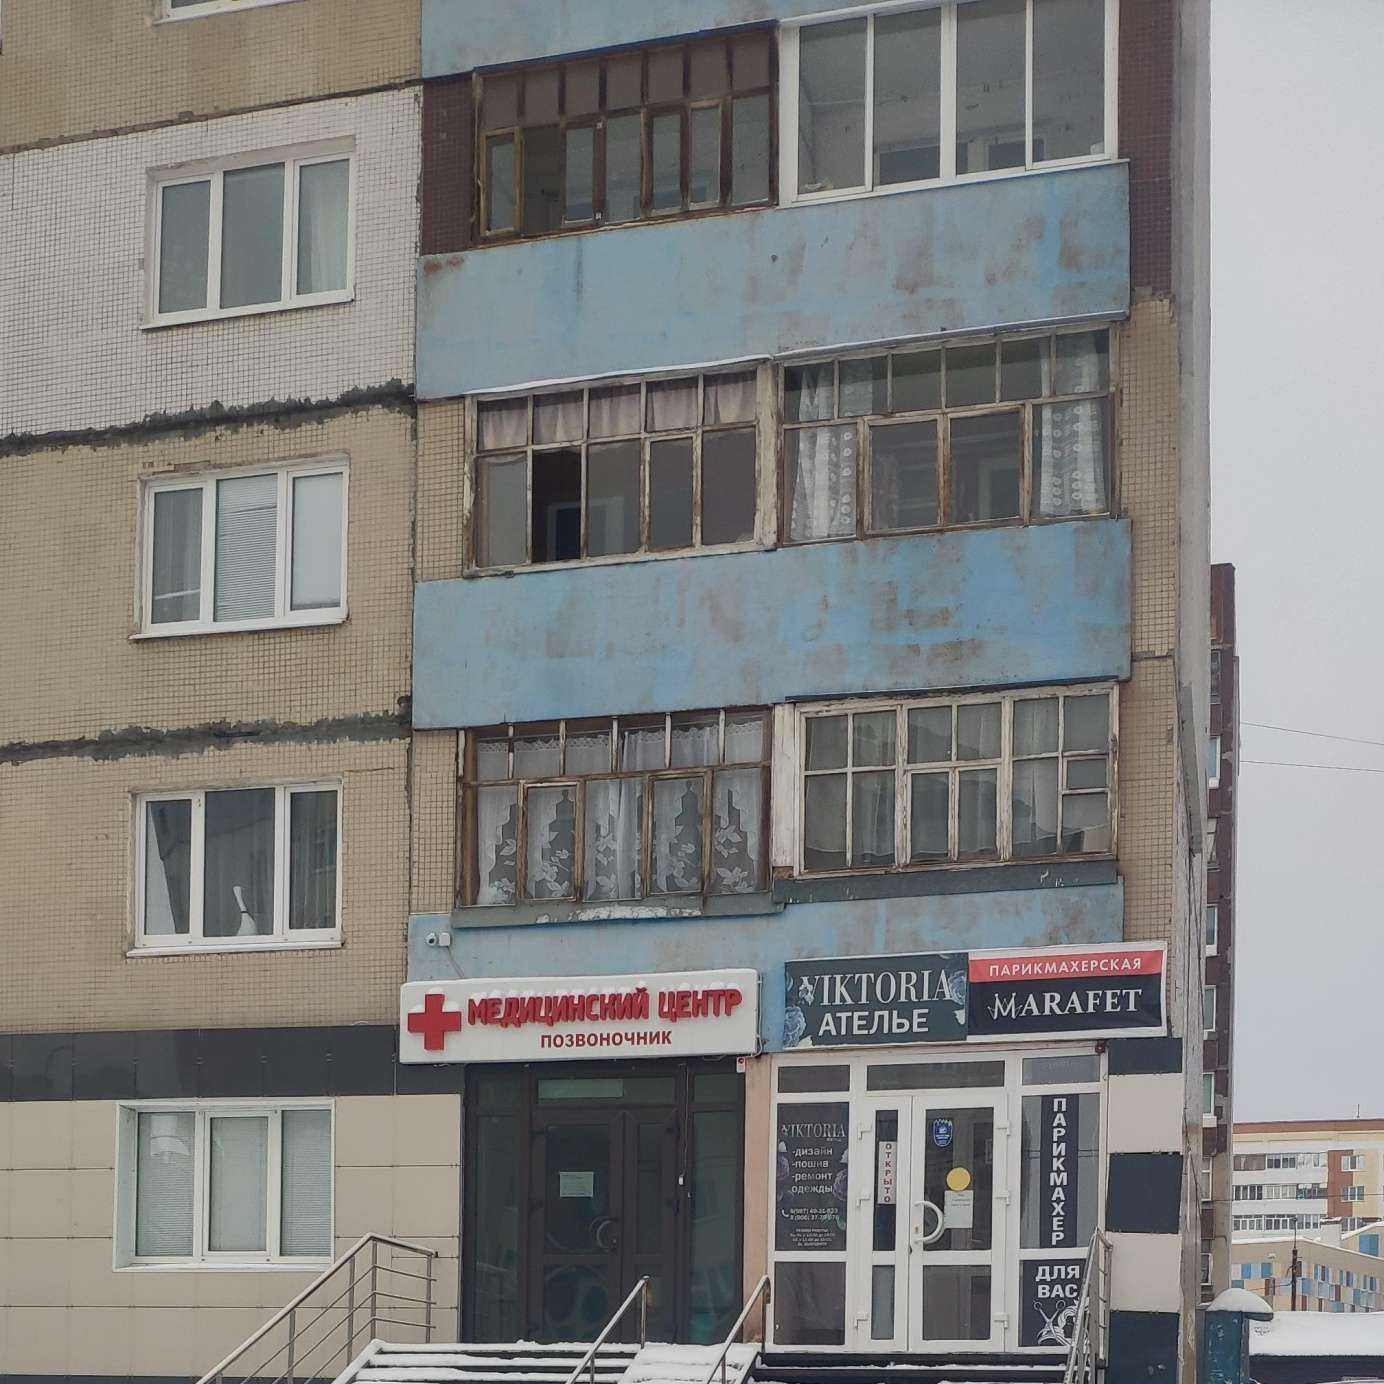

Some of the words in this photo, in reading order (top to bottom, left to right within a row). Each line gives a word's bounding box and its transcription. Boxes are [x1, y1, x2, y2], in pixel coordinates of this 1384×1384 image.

[989, 957, 1142, 977] ПАРИКМАХЕРСКАЯ
[798, 969, 953, 1006] VIKTORIA
[467, 987, 650, 1028] МЕДИЦИНСКИЙ
[658, 988, 743, 1023] ЦЕНТР
[988, 989, 1142, 1021] MARAFET
[818, 1008, 929, 1037] АТЕЛЬЕ
[540, 1030, 672, 1049] ПОЗВОНОЧНИК
[782, 1123, 846, 1138] VIKTORIA
[883, 1143, 893, 1203] ОТКРЫТО
[1049, 1097, 1068, 1246] ПАРИКМАХЕР
[791, 1185, 833, 1194] одежды
[1035, 1265, 1080, 1282] ДЛЯ
[1037, 1284, 1079, 1299] ВАС
